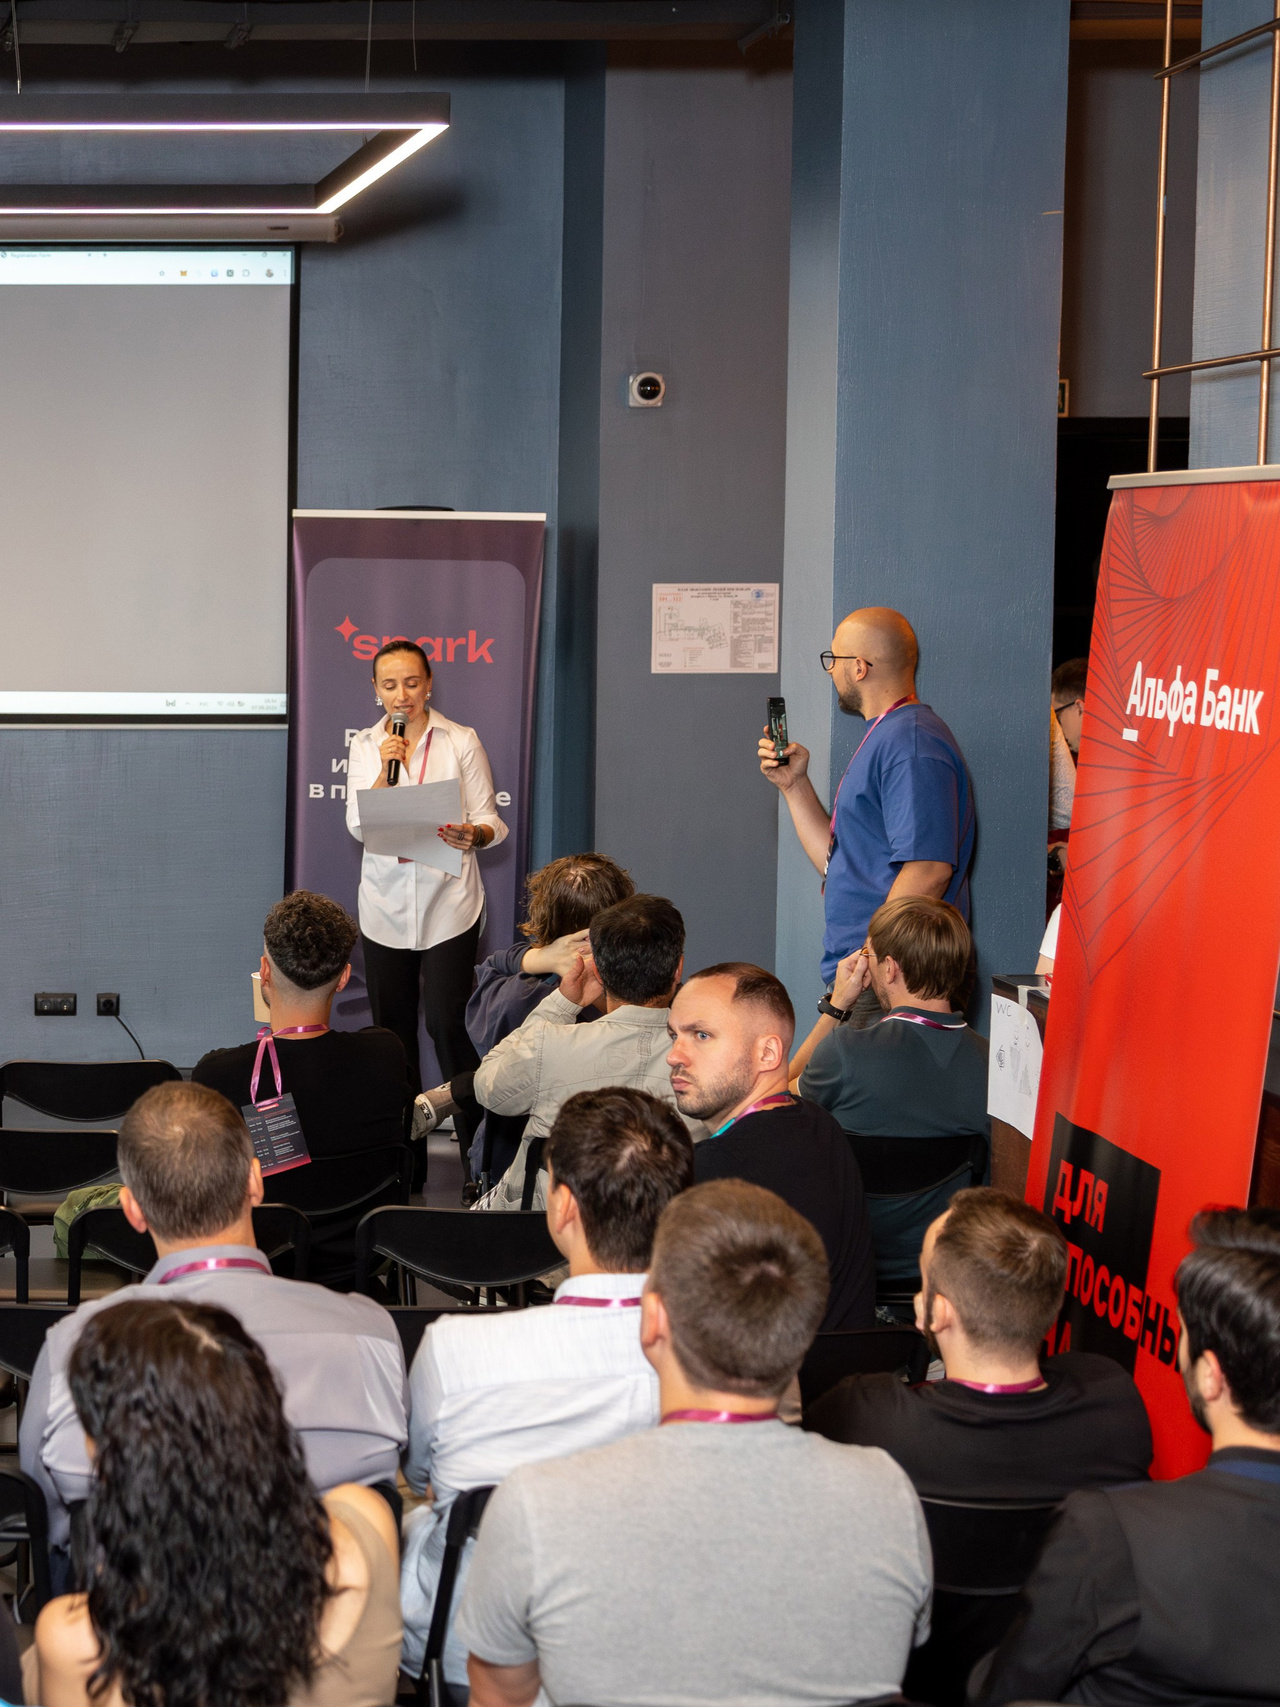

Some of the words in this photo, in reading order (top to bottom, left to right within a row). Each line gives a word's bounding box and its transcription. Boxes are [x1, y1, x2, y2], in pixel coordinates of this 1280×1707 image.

[352, 630, 495, 663] sark
[1125, 660, 1198, 738] Альфа
[1199, 668, 1264, 735] Банк
[996, 1001, 1012, 1017] WC
[1052, 1159, 1109, 1233] ДЛЯ
[1065, 1241, 1181, 1372] ПОСОБНЫ
